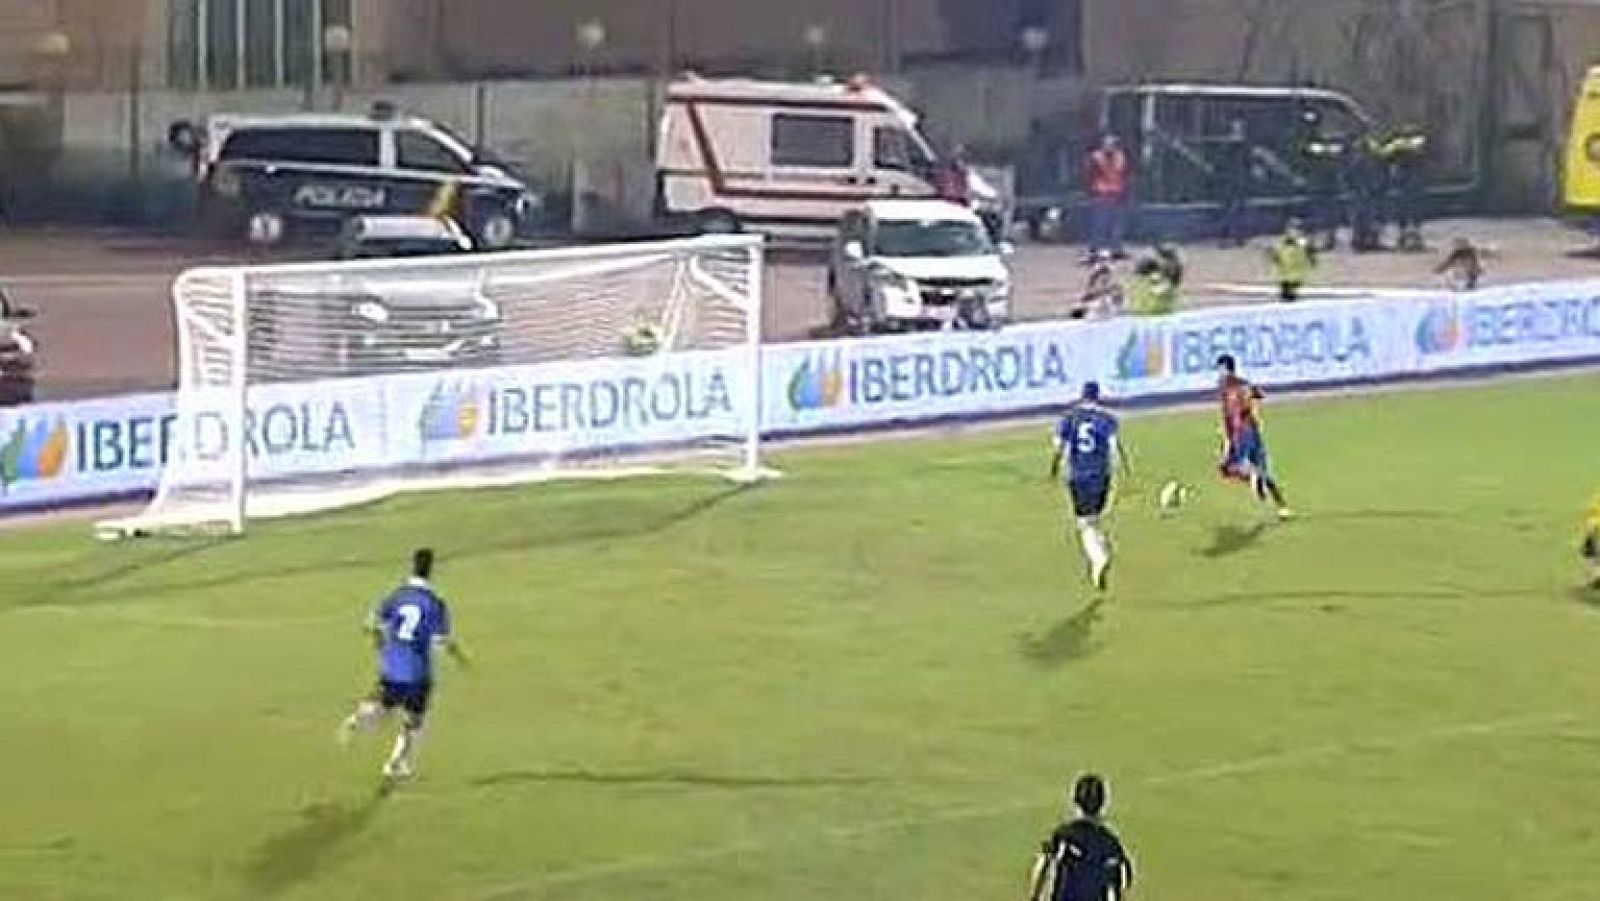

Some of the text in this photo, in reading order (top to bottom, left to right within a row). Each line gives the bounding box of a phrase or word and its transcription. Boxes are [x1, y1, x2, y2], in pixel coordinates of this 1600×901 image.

[487, 367, 732, 435] IBERDROLA
[849, 344, 1067, 404] IBERDROLA
[1078, 422, 1096, 454] 5
